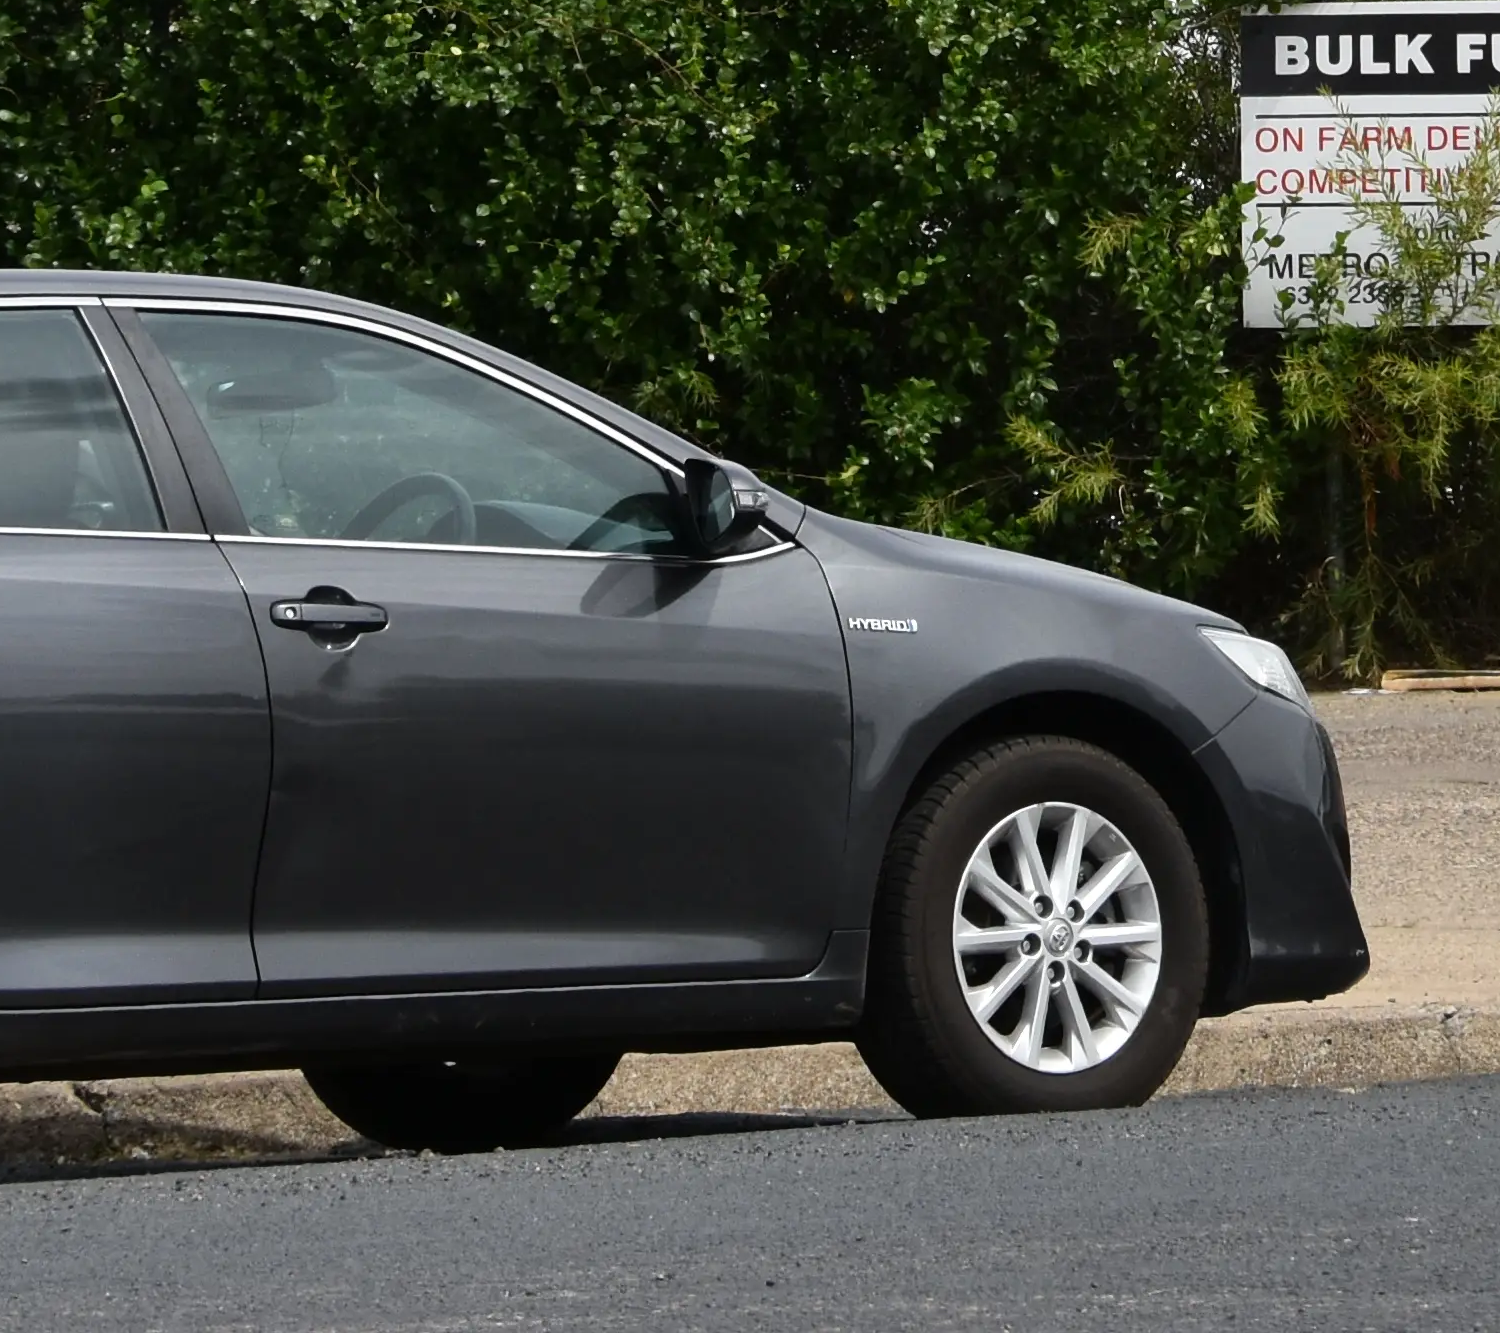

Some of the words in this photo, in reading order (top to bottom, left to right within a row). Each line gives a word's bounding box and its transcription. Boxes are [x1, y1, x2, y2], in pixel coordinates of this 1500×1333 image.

[1275, 34, 1434, 76] BULK
[1255, 127, 1303, 153] ON
[1318, 126, 1413, 152] FARM
[849, 617, 908, 633] HYBRID
